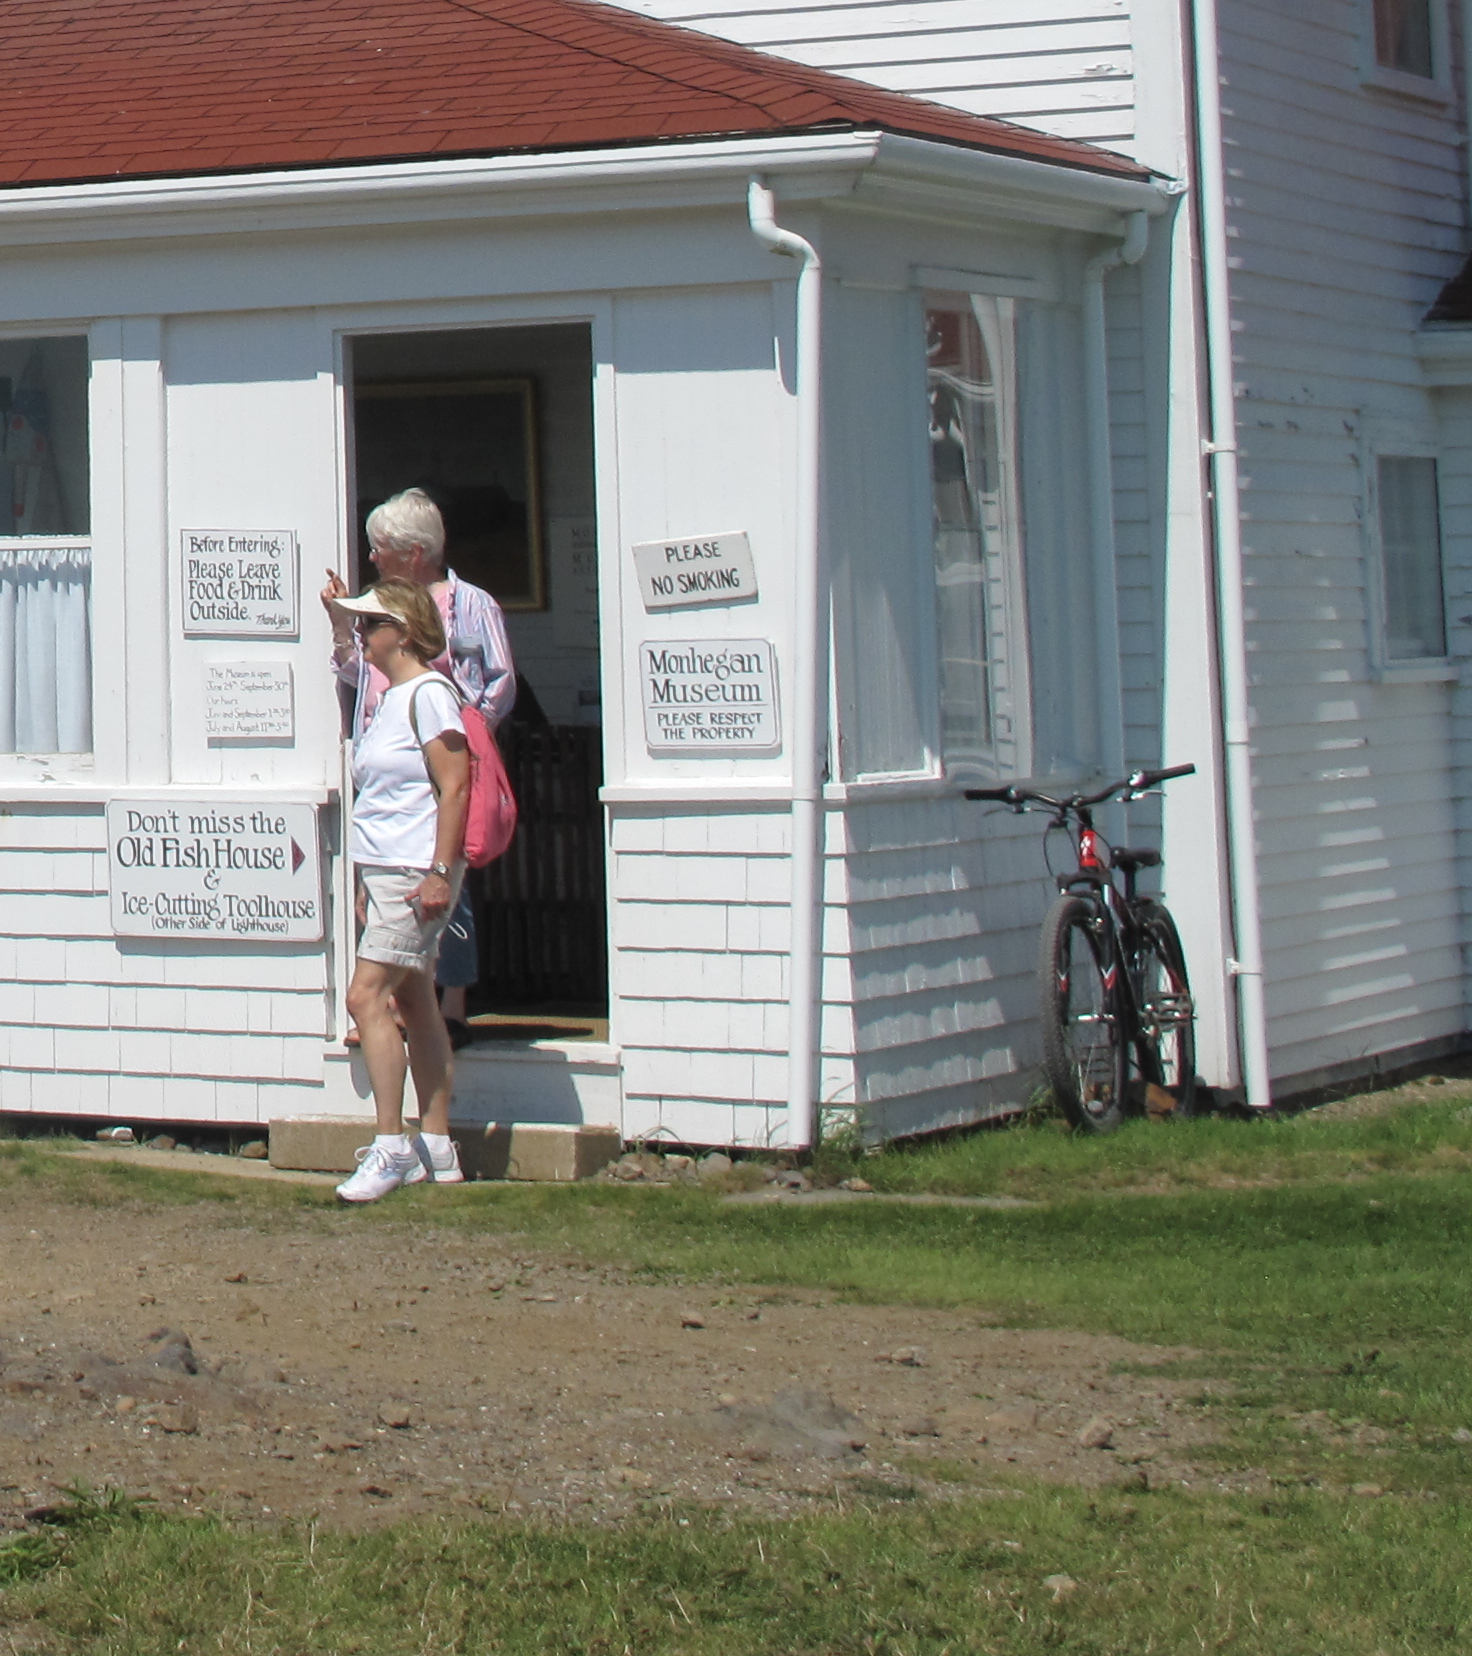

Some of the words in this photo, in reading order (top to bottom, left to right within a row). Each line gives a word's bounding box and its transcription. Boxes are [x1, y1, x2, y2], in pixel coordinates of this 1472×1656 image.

[189, 536, 225, 553] Before
[228, 534, 285, 559] Entering:
[664, 542, 722, 563] PLEASE
[188, 559, 234, 579] Please
[237, 559, 281, 579] Leave
[188, 578, 225, 600] Food
[240, 579, 283, 601] Drink
[651, 575, 674, 596] NO
[677, 567, 740, 594] SMOKING
[189, 600, 252, 621] Outside.
[647, 647, 763, 681] Monhegan
[649, 678, 762, 703] Museum
[657, 712, 703, 726] PLEASE
[709, 712, 762, 725] RESPECT
[662, 727, 686, 740] THE
[692, 726, 755, 740] PROPERTY
[126, 809, 180, 833] Don't
[188, 809, 246, 834] miss
[249, 811, 287, 835] the
[116, 836, 154, 868] Old
[160, 838, 210, 869] Fish
[212, 838, 286, 870] House
[203, 869, 221, 891] &
[121, 891, 221, 921] Ice-Cutting
[223, 894, 316, 919] Toolhouse
[188, 917, 211, 931] Side
[215, 917, 226, 931] of
[231, 919, 290, 935] Lighthouse)
